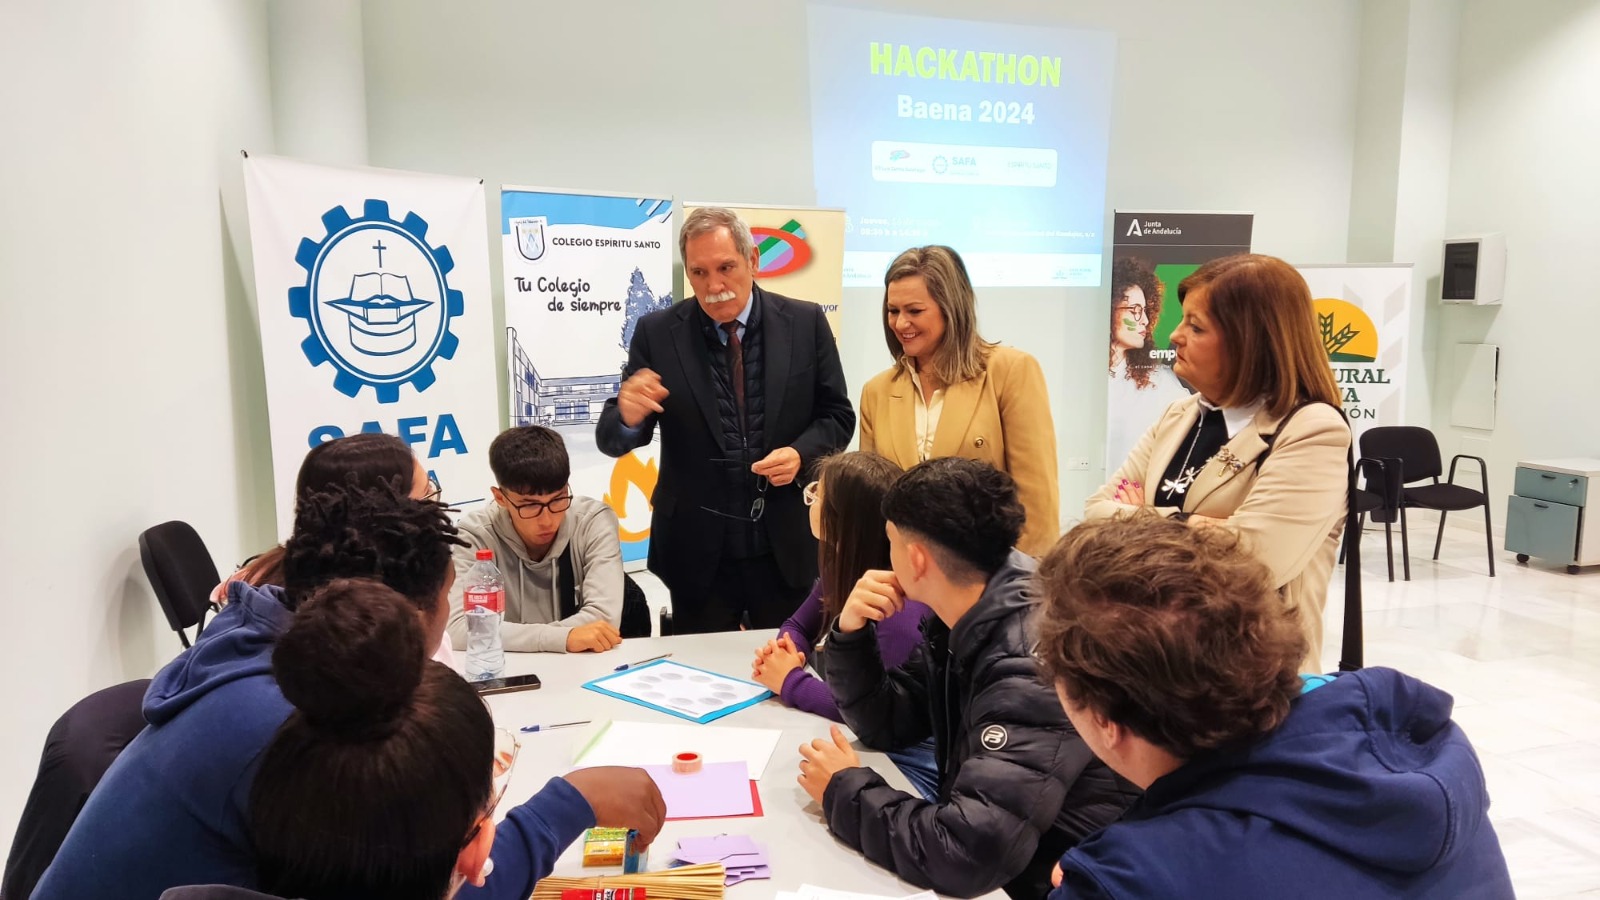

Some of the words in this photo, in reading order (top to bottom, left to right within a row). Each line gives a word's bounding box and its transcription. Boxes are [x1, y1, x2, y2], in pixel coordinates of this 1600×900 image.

[869, 41, 1062, 88] HACKATHON
[897, 94, 972, 122] Baena
[978, 100, 1035, 125] 2024
[952, 156, 977, 167] SAFA
[1143, 227, 1152, 235] de
[1144, 220, 1162, 228] Junta
[552, 237, 593, 247] COLEGIO
[595, 237, 632, 248] ESPÍRITU
[634, 240, 661, 249] SANTO
[514, 276, 532, 293] Tu
[537, 275, 591, 298] Colegio
[547, 296, 565, 312] de
[570, 297, 622, 316] siempre
[1332, 368, 1391, 384] URAL
